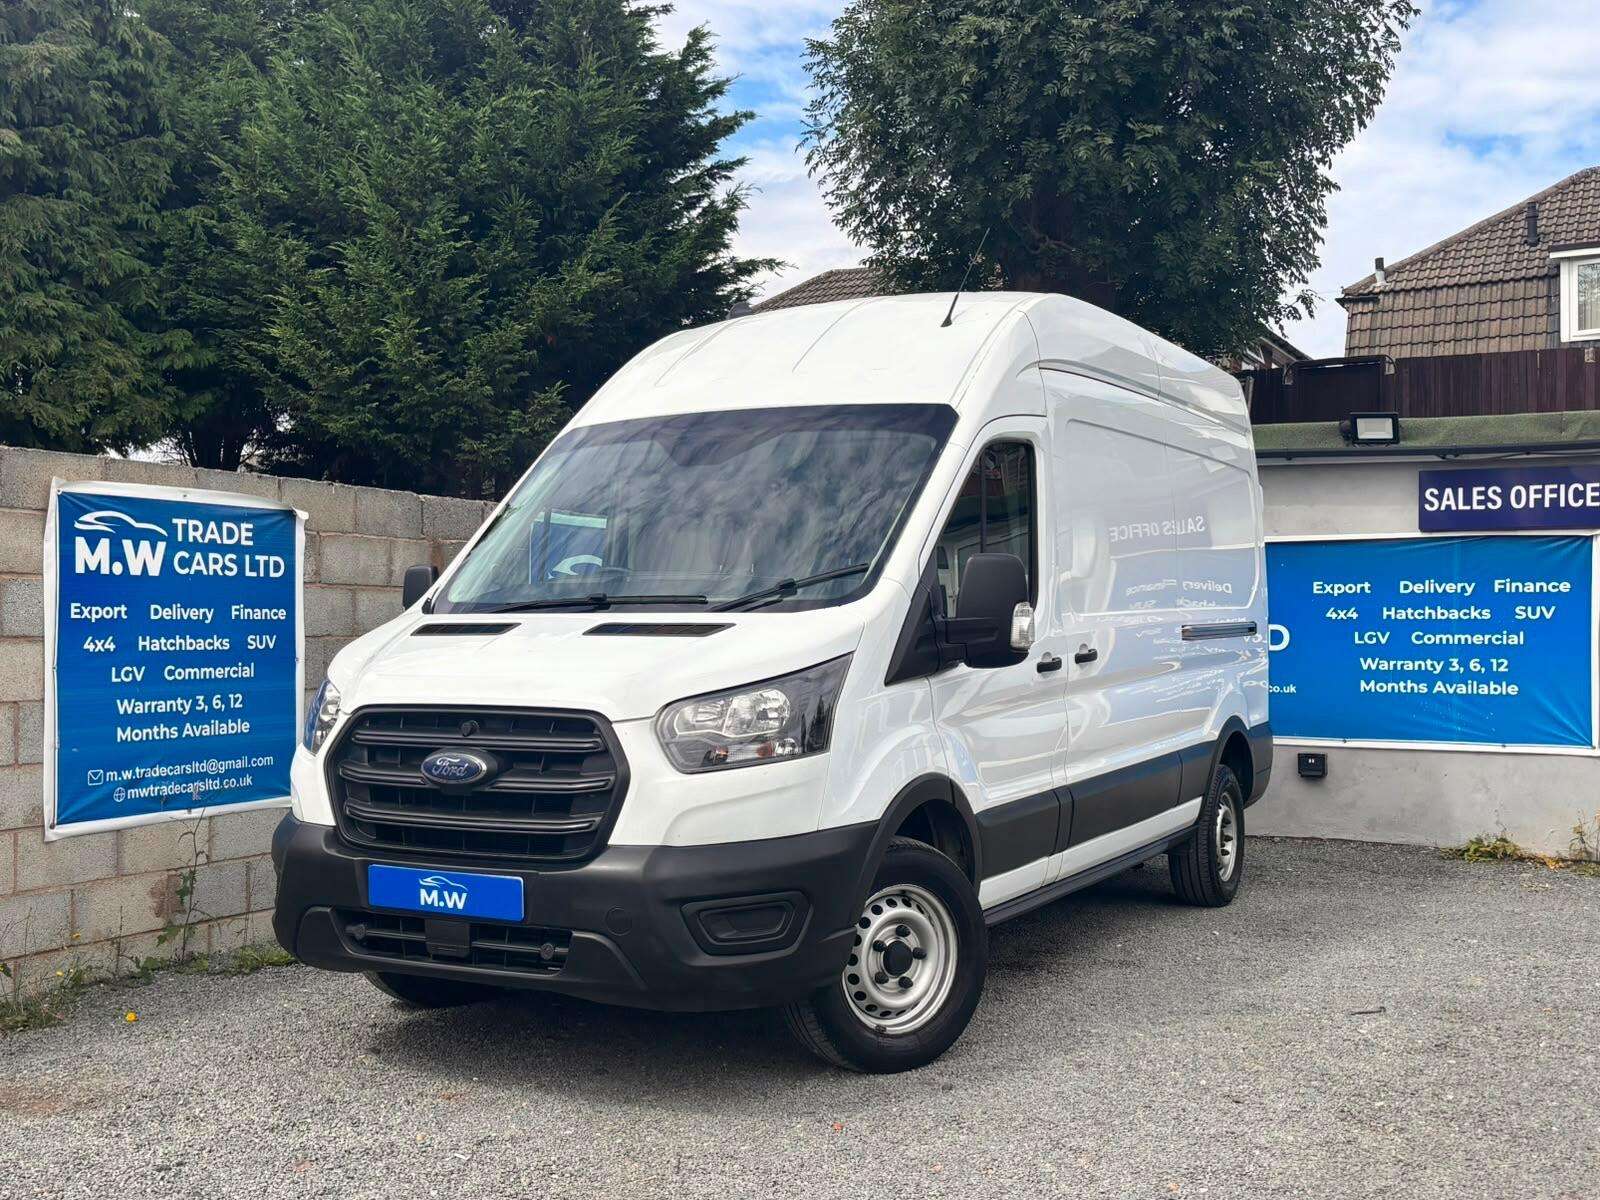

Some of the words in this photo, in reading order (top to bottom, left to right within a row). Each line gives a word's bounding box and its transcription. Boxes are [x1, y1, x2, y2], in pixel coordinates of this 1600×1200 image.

[1424, 486, 1502, 511] SALES
[1510, 482, 1600, 509] OFFICE
[172, 518, 254, 546] TRADE
[74, 537, 167, 576] M.W
[172, 551, 238, 577] CARS
[244, 556, 285, 578] LTD
[1313, 581, 1371, 596] Export
[1399, 579, 1475, 596] Delivery
[1494, 579, 1571, 594] Finance
[70, 602, 128, 623] Export
[150, 604, 214, 625] Delivery
[231, 605, 287, 621] Finance
[1325, 606, 1358, 620] 4x4
[1382, 605, 1491, 620] Hatchbacks
[1514, 605, 1556, 619] SUV
[83, 636, 116, 652] 4x4
[138, 634, 230, 652] Hatchbacks
[247, 634, 277, 650] SUV
[1354, 631, 1390, 645] LGV
[1411, 631, 1524, 645] Commercial
[111, 666, 146, 682] LGV
[164, 662, 255, 681] Commercial
[1360, 658, 1444, 674] Warranty
[1449, 659, 1464, 674] 3,
[1469, 659, 1485, 674] 6,
[1490, 659, 1508, 672] 12
[1360, 681, 1427, 694] Months
[1432, 681, 1519, 696] Available
[116, 697, 192, 715] Warranty
[195, 696, 209, 714] 3,
[212, 696, 226, 712] 6,
[229, 694, 243, 709] 12
[116, 723, 178, 742] Months
[182, 719, 251, 738] Available
[106, 755, 274, 782] m.w.tradecarsltd@gmail.com
[432, 756, 468, 777] Ford
[420, 888, 467, 910] M.W
